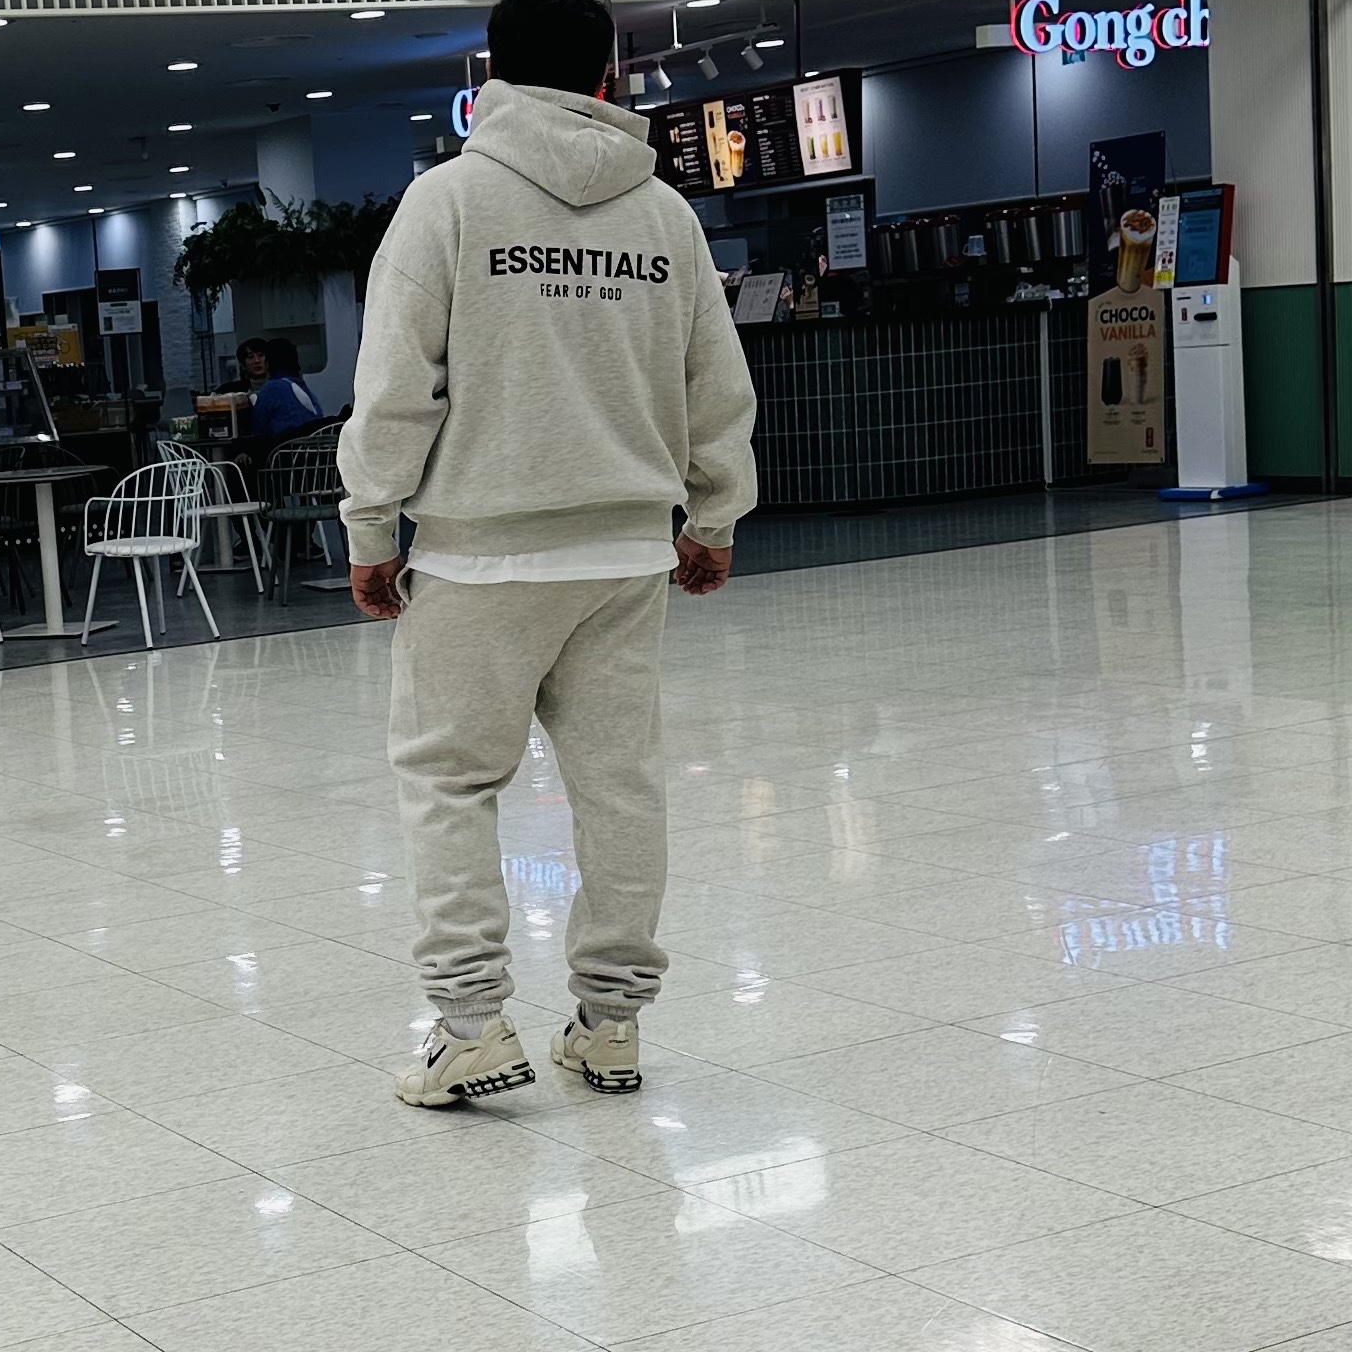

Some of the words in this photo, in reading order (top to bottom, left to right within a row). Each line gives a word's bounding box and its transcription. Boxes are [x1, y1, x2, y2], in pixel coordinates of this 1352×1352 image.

[489, 246, 670, 284] ESSENTIALS
[540, 283, 569, 298] FEAR
[575, 285, 593, 299] OF
[599, 286, 623, 301] GOD
[1099, 306, 1156, 325] CHOCO&
[1099, 324, 1157, 342] VANILLA
